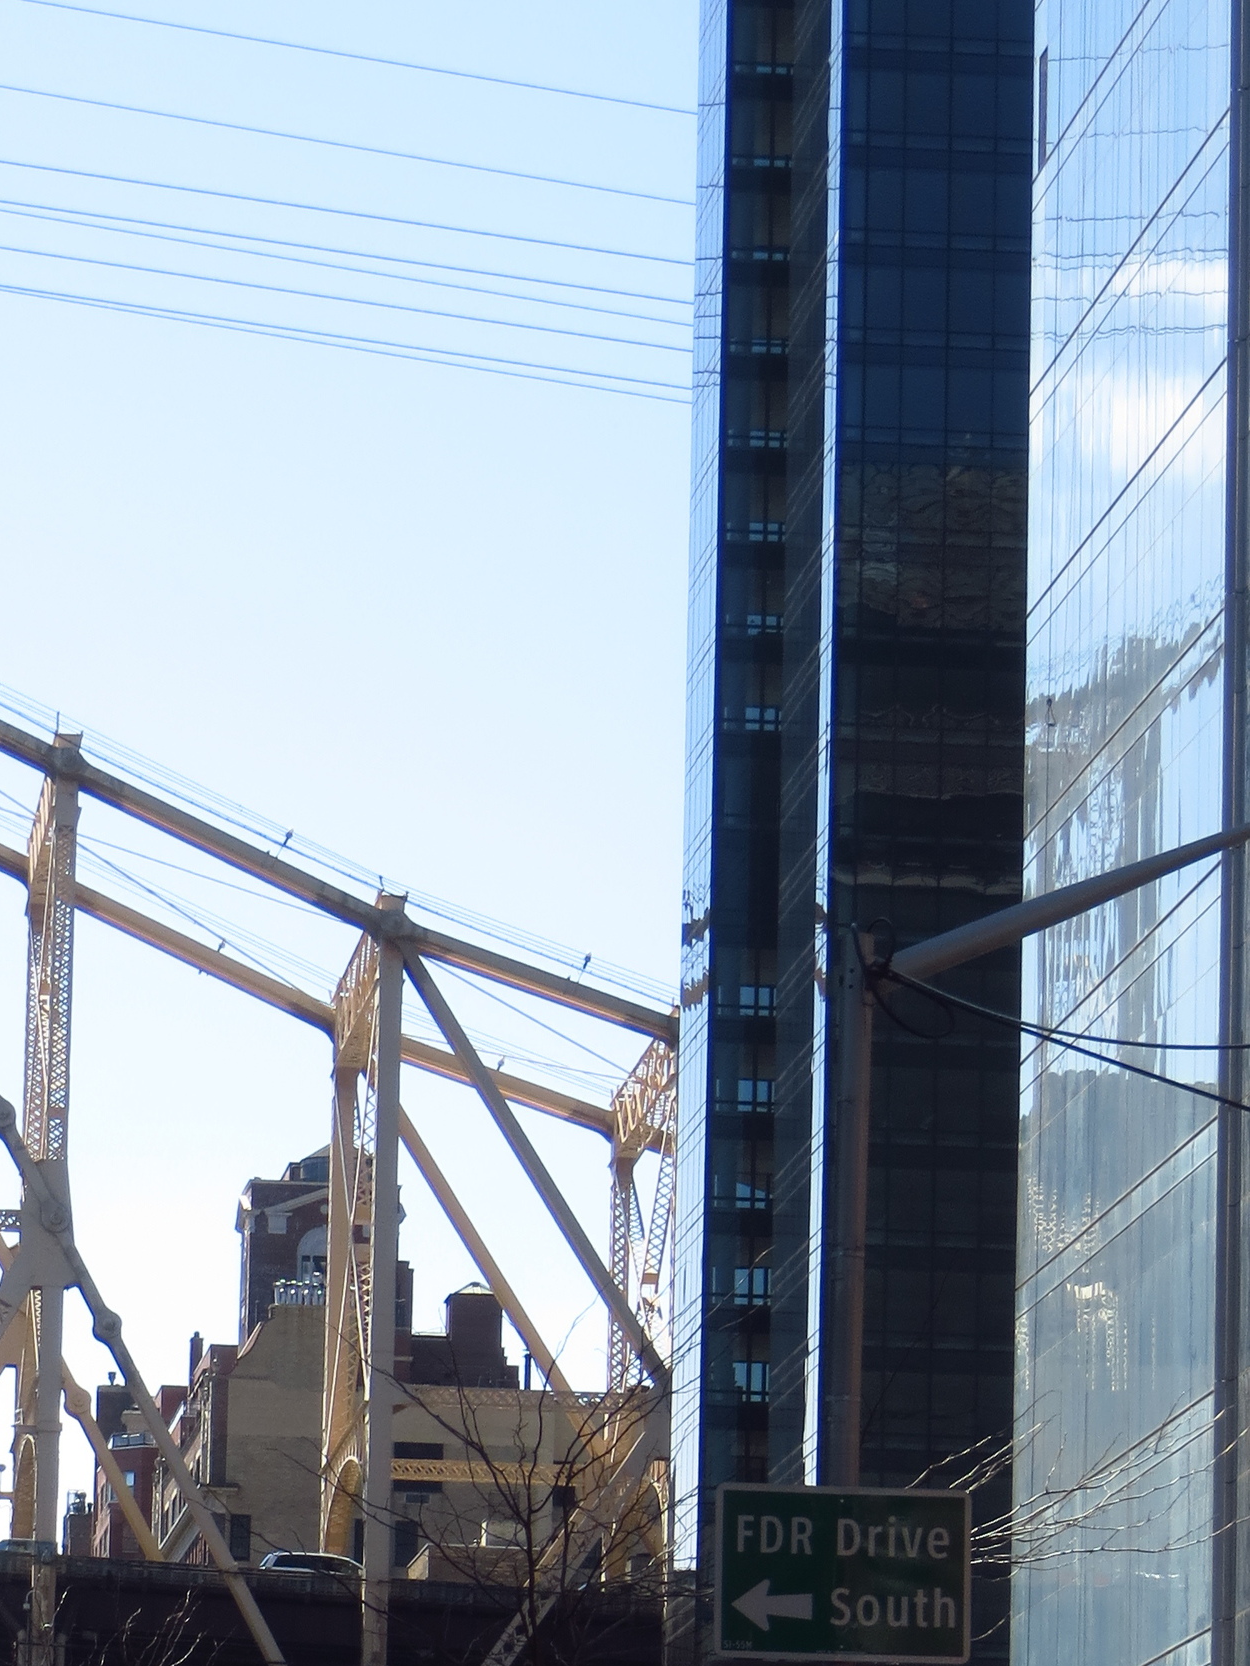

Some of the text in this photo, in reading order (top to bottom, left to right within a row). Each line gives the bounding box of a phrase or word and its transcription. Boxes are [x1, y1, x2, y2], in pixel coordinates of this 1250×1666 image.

[736, 1514, 950, 1559] FDR Drive
[829, 1587, 956, 1629] South
